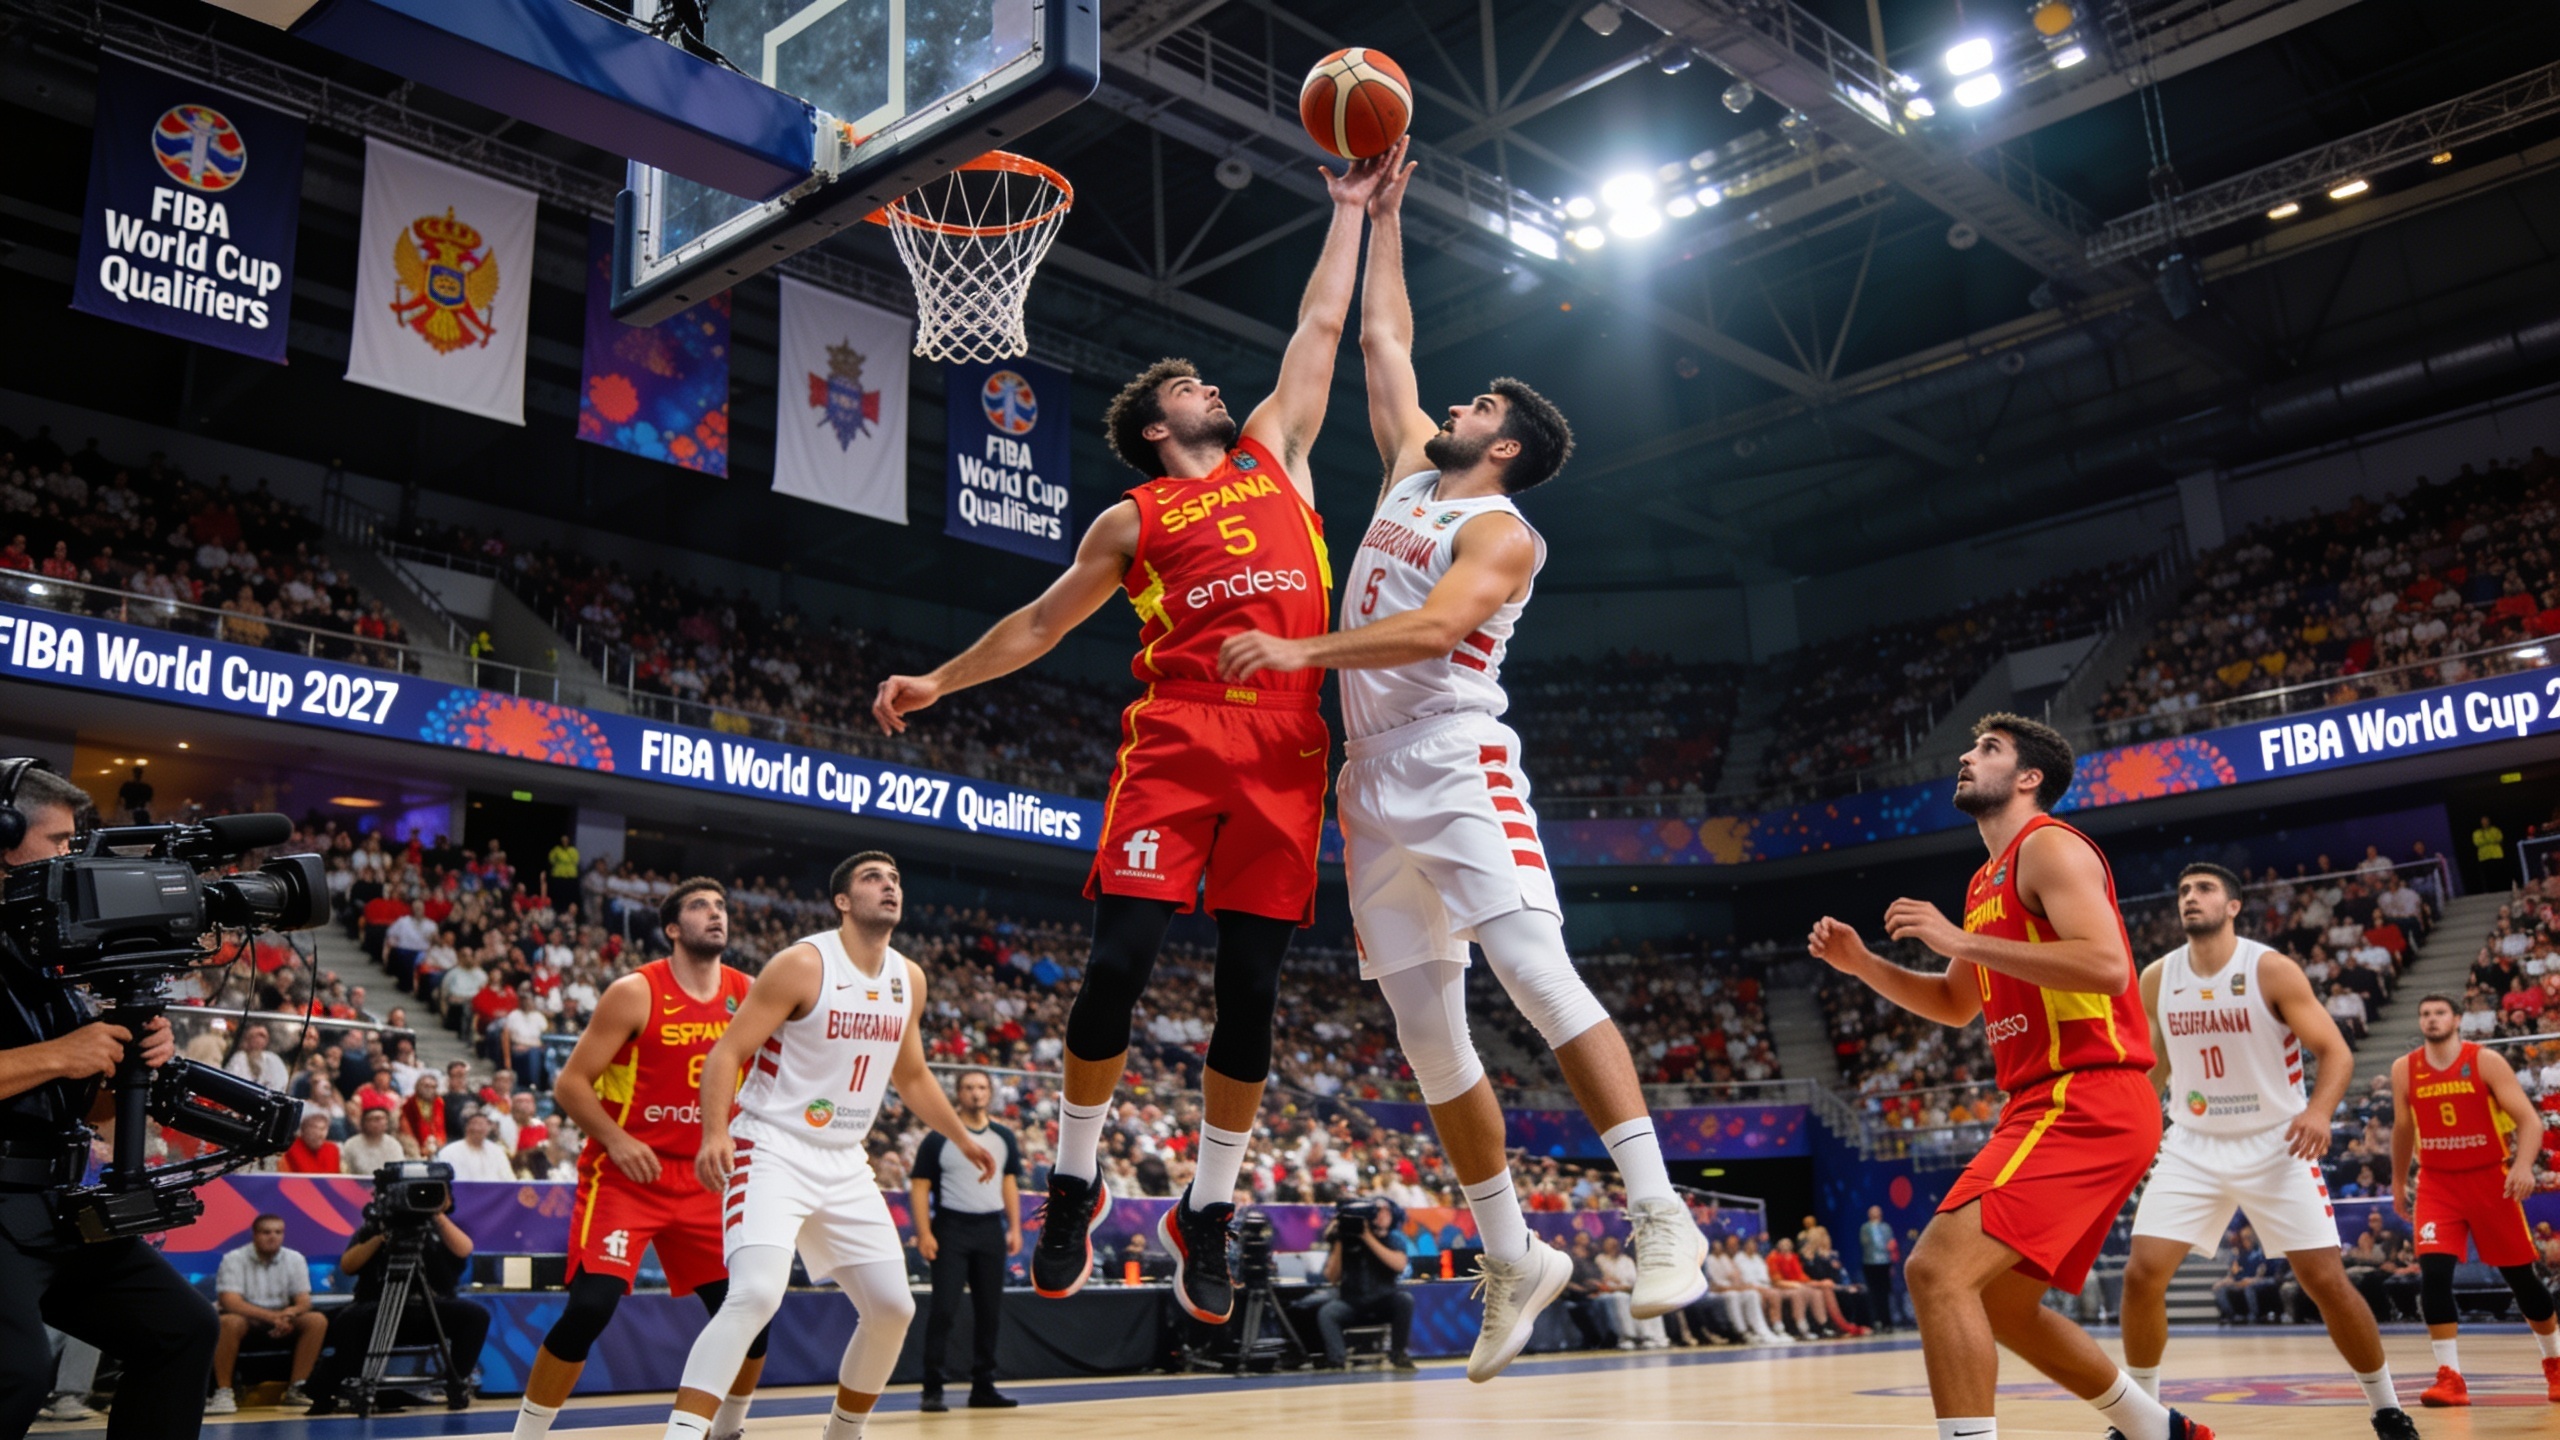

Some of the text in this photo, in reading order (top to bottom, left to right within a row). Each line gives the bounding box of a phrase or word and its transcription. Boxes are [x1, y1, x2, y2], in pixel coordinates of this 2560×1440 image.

[151, 186, 230, 240] FIBA
[105, 208, 281, 297] World Cup
[100, 254, 269, 329] Qualifiers
[986, 434, 1033, 471] FIBA
[957, 453, 1068, 515] World Cup
[958, 488, 1062, 540] Qualifiers
[1160, 473, 1282, 534] SSPANA
[1217, 515, 1257, 555] 5
[97, 631, 212, 696] World
[221, 656, 293, 717] Cup
[301, 670, 399, 725] 2027
[2259, 718, 2344, 771] FIBA
[2347, 696, 2458, 754] World
[2464, 691, 2539, 737] Cup
[640, 730, 1082, 840] FIBA World Cup 2027 Qualifiers
[848, 1054, 871, 1092] 11
[2199, 1045, 2225, 1079] 10
